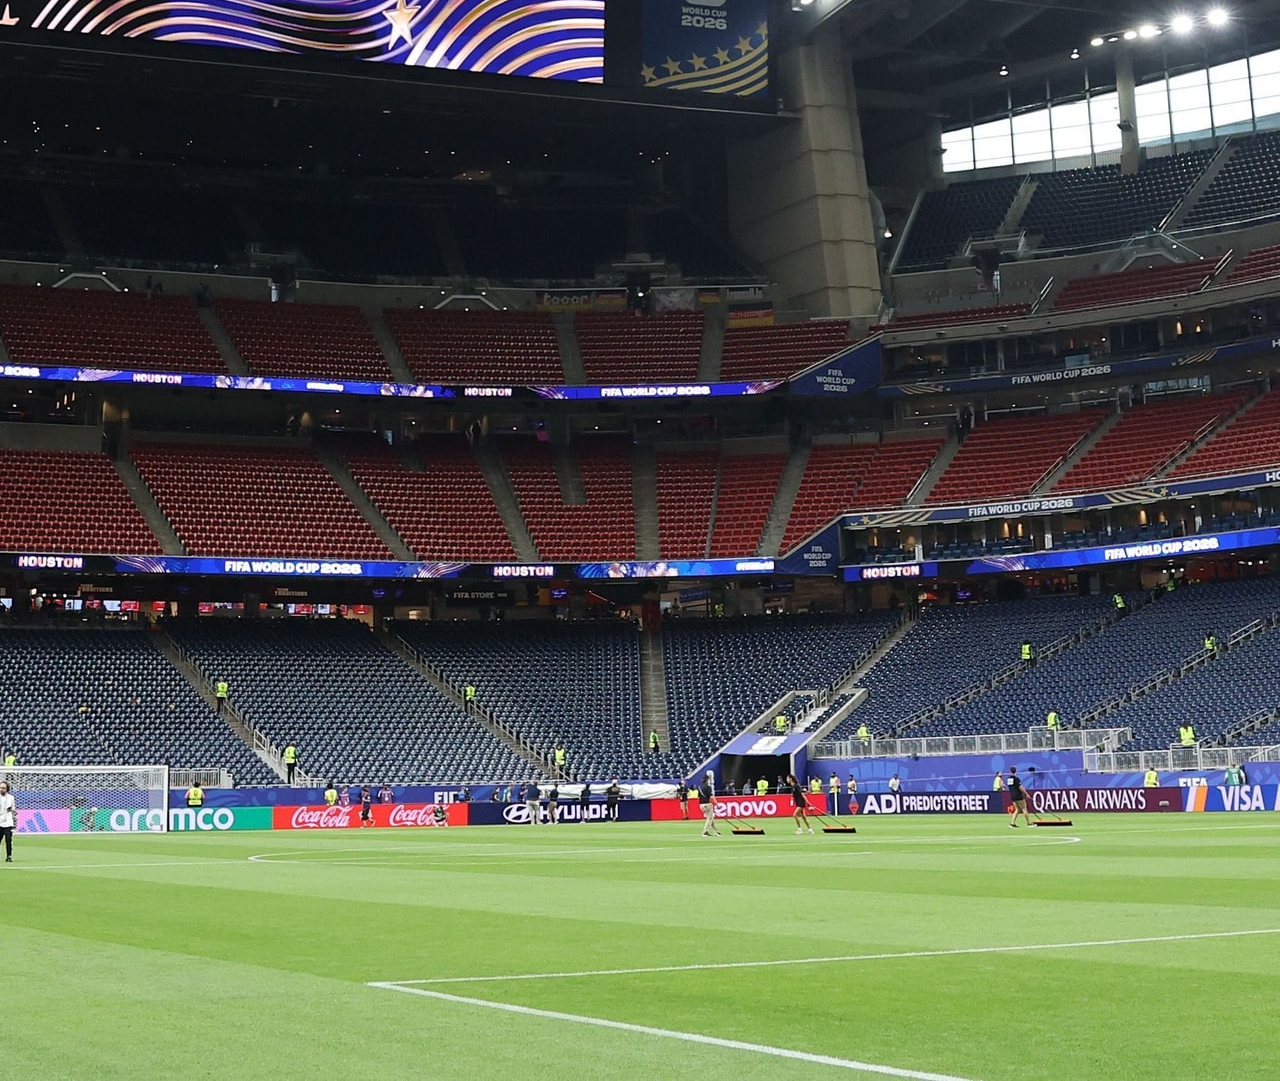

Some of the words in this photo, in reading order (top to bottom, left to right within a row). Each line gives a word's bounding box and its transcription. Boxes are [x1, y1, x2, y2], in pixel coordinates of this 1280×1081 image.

[682, 6, 710, 16] WORLD
[712, 9, 727, 18] CUP
[681, 16, 727, 30] 2026
[132, 373, 182, 384] HOUSTON
[828, 369, 842, 377] FIFA
[1011, 375, 1031, 385] FIFA
[1032, 372, 1062, 383] WORLD
[1063, 369, 1080, 379] CUP
[1081, 365, 1111, 377] 2026
[816, 376, 840, 384] WORLD
[842, 377, 855, 385] CUP
[464, 387, 512, 397] HOUSTON
[601, 387, 622, 397] FIFA
[622, 387, 656, 396] WORLD
[657, 387, 676, 396] CUP
[823, 384, 848, 392] 2026
[968, 507, 988, 517] FIFA
[988, 504, 1021, 515] WORLD
[1022, 502, 1040, 511] CUP
[1041, 499, 1073, 510] 2026
[1105, 548, 1126, 560] FIFA
[1125, 544, 1161, 558] WORLD
[1162, 542, 1182, 553] CUP
[18, 556, 83, 568] HOUSTON
[224, 560, 251, 572] FIFA
[251, 561, 295, 573] WORLD
[295, 562, 320, 574] CUP
[320, 563, 362, 574] 2026
[493, 566, 553, 576] HOUSTON
[863, 565, 920, 578] HOUSTON
[471, 591, 494, 599] STORE
[1178, 777, 1208, 787] FIFA
[862, 794, 900, 814] ADI
[902, 795, 989, 811] PREDICTSTREET
[1032, 790, 1080, 813] QATAR
[1085, 789, 1146, 810] AIRWAYS
[1216, 784, 1265, 811] VISA
[705, 800, 777, 817] enovo
[110, 808, 235, 831] aramco
[291, 805, 354, 828] Coca-Cola
